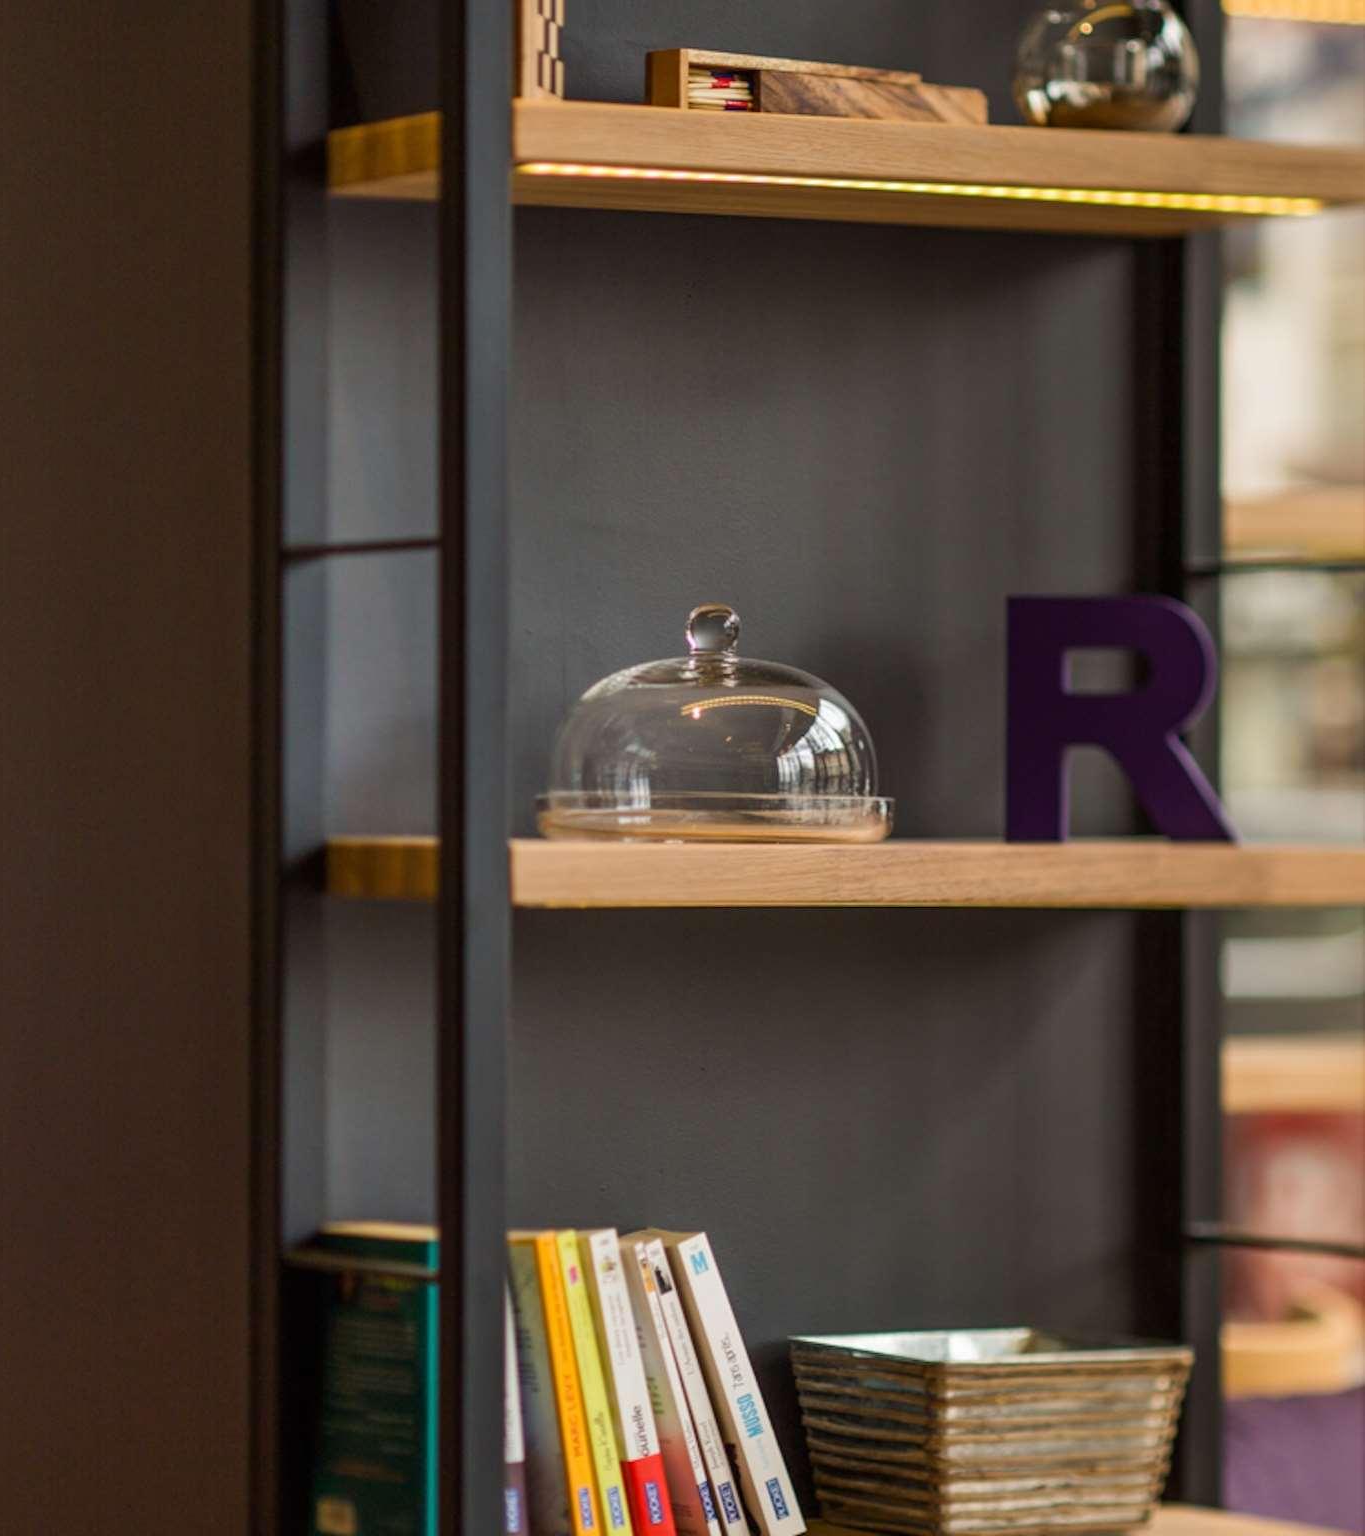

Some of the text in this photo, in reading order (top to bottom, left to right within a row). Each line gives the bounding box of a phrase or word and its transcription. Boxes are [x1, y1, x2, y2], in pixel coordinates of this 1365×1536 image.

[1006, 595, 1239, 843] R
[736, 1393, 764, 1437] MUSSO
[765, 1477, 789, 1520] POCKET
